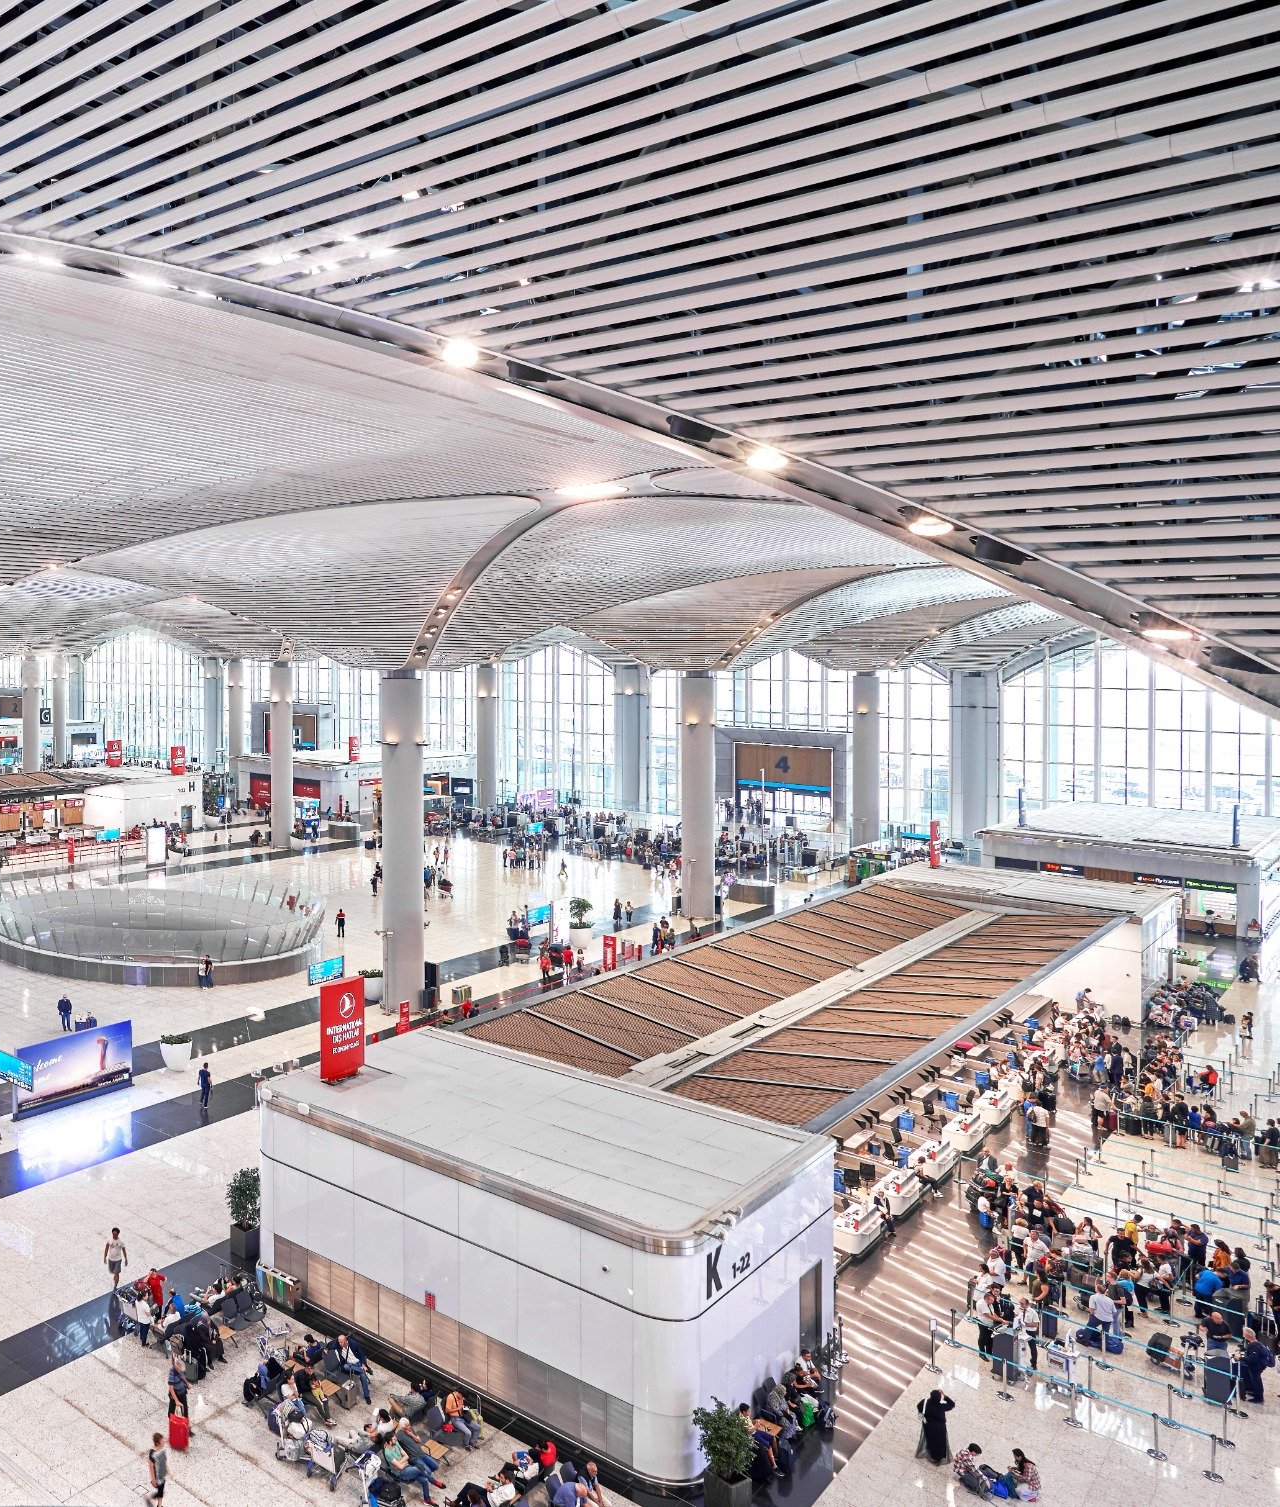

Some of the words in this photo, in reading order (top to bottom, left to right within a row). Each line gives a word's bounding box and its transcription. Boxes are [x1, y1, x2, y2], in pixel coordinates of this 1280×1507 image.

[11, 703, 18, 713] 2
[41, 709, 50, 723] G
[775, 756, 790, 773] 4
[188, 781, 196, 792] H
[33, 1055, 62, 1073] elcome
[706, 1244, 723, 1300] K
[731, 1252, 751, 1279] 1-22
